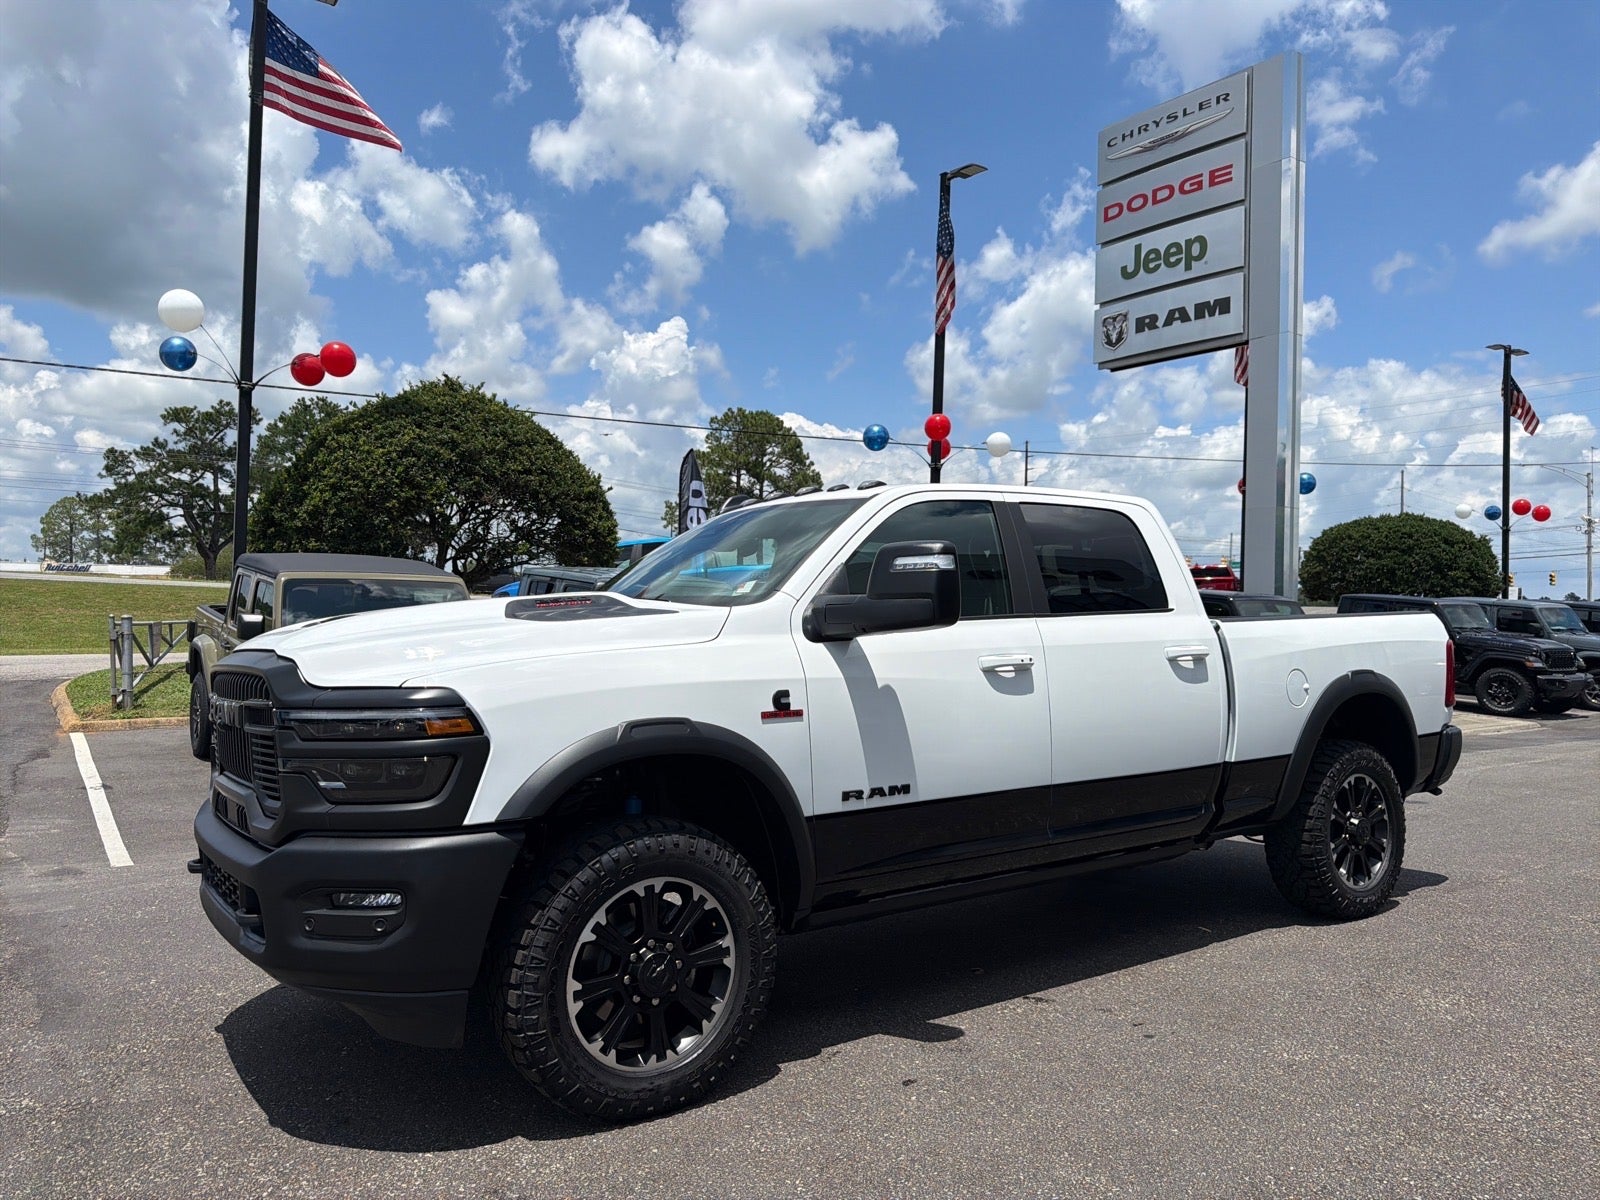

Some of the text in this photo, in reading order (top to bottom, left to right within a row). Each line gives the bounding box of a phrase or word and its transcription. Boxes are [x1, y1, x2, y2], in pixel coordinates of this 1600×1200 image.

[1106, 92, 1231, 148] CHRYSLER
[1103, 164, 1234, 223] DODGE
[1120, 234, 1208, 281] Jeep
[1134, 296, 1232, 335] RAM
[841, 784, 911, 802] RAM
